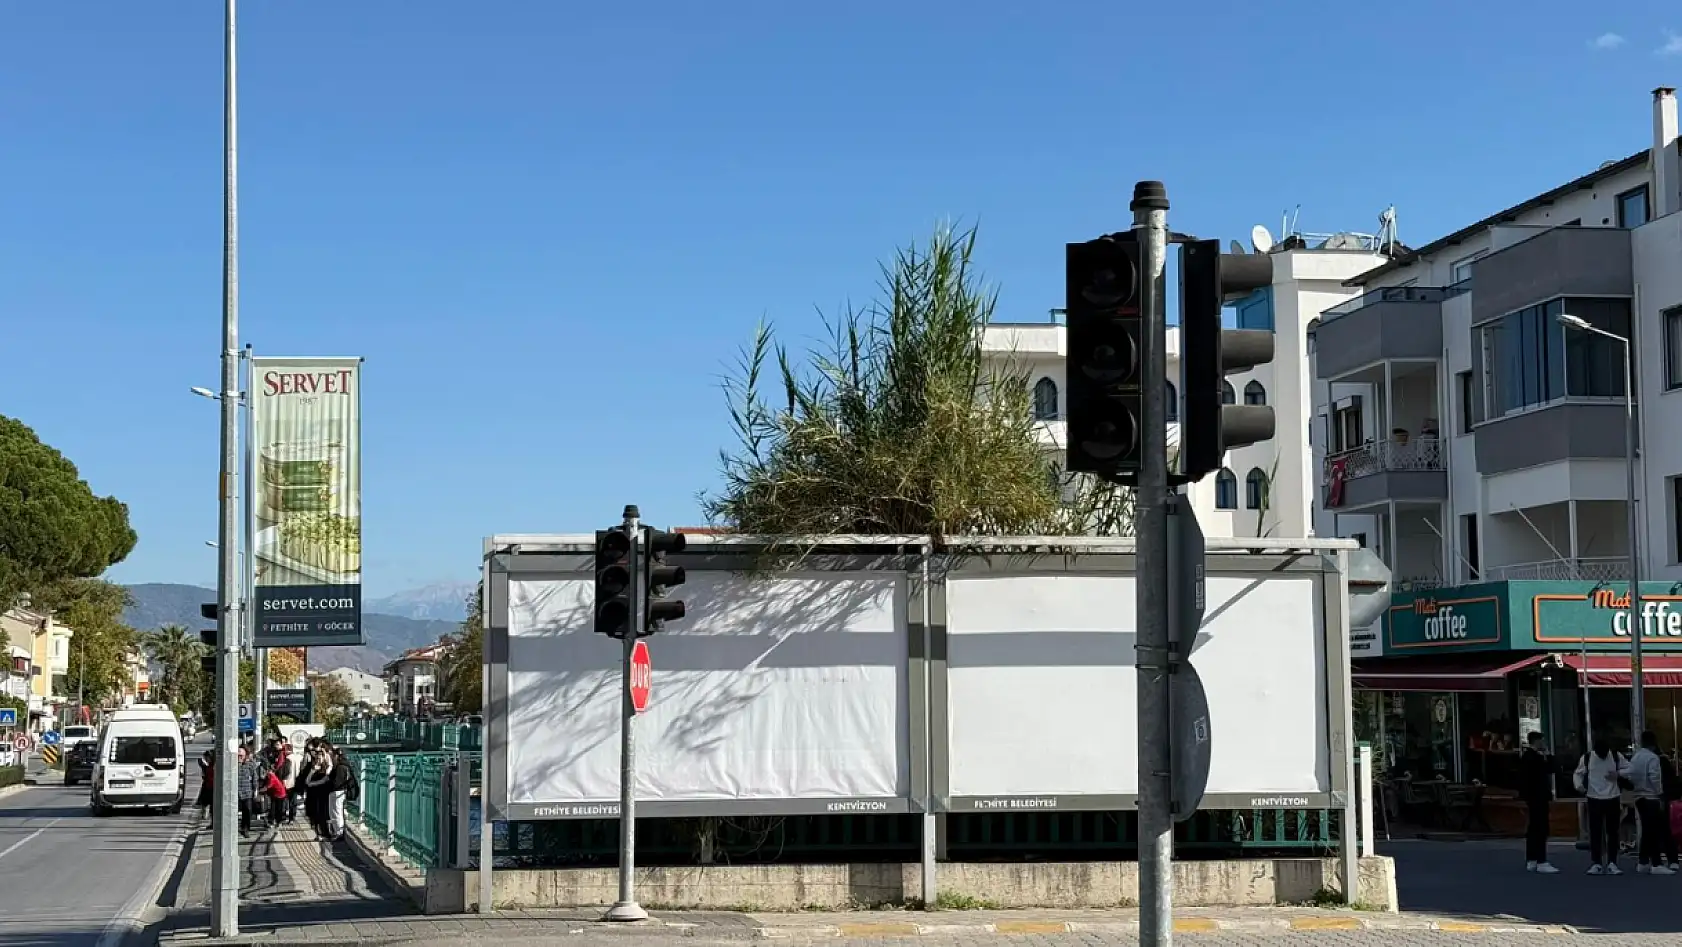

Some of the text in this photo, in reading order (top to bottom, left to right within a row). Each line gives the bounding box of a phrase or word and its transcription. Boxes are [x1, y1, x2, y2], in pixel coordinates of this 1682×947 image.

[263, 369, 352, 397] SERVET
[263, 597, 354, 611] servet.com
[1593, 589, 1632, 609] Mat
[1424, 605, 1467, 640] coffee
[630, 662, 649, 689] DUR
[827, 800, 887, 812] KENTVİZYON
[1250, 795, 1309, 807] KENTVİZYON
[534, 804, 570, 817] FETHİYE
